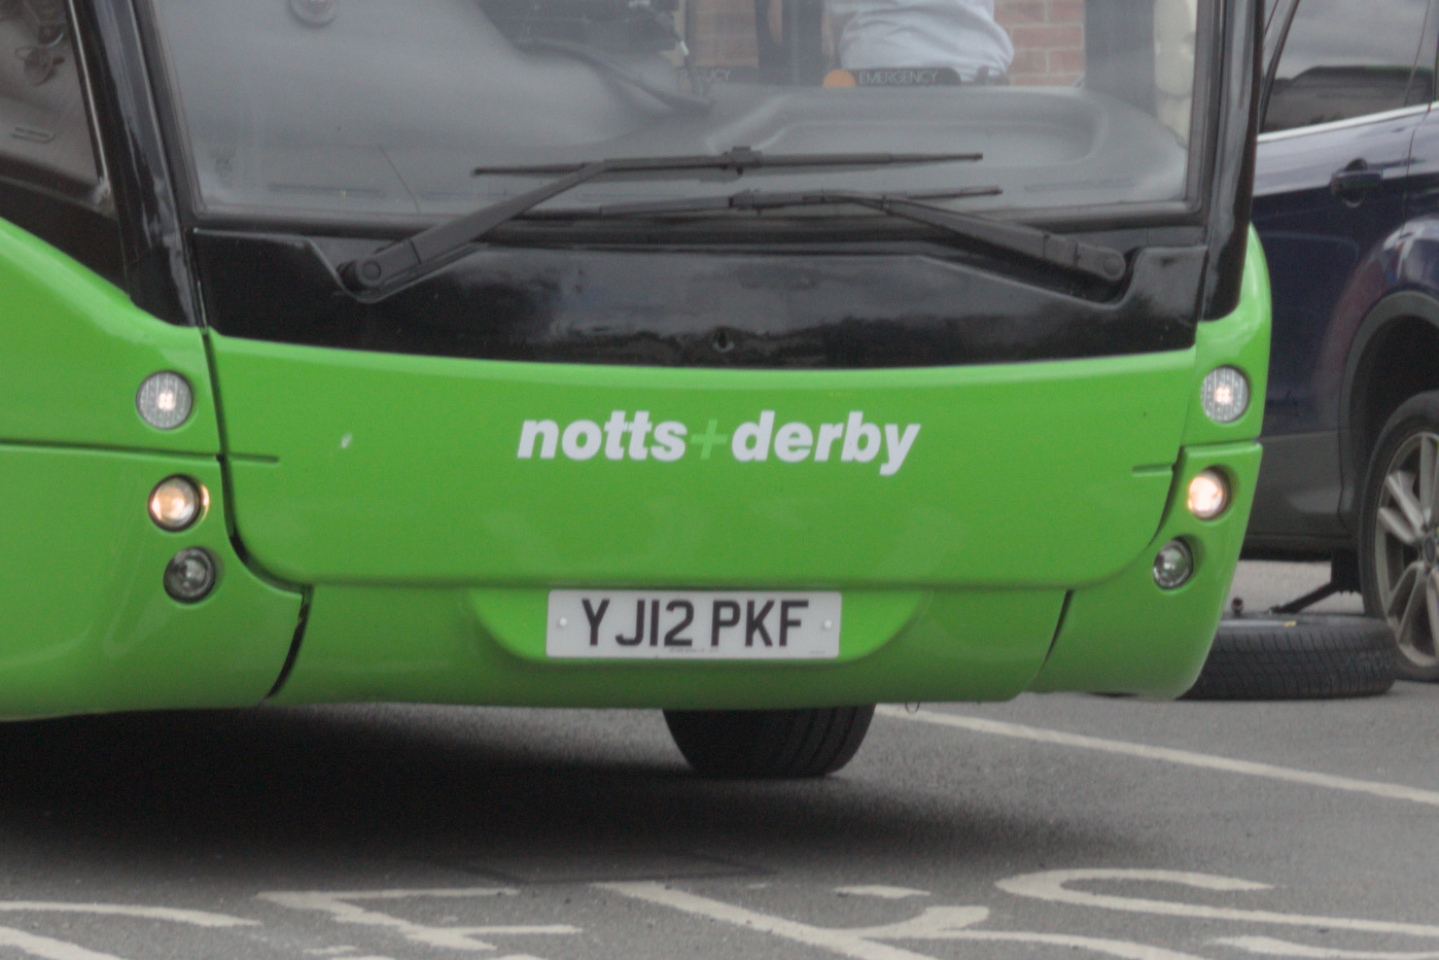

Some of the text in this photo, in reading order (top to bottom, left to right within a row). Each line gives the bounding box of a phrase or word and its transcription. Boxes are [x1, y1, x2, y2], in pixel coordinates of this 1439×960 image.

[858, 68, 938, 85] EMERGENCY
[580, 598, 810, 648] YJ12 PKF
